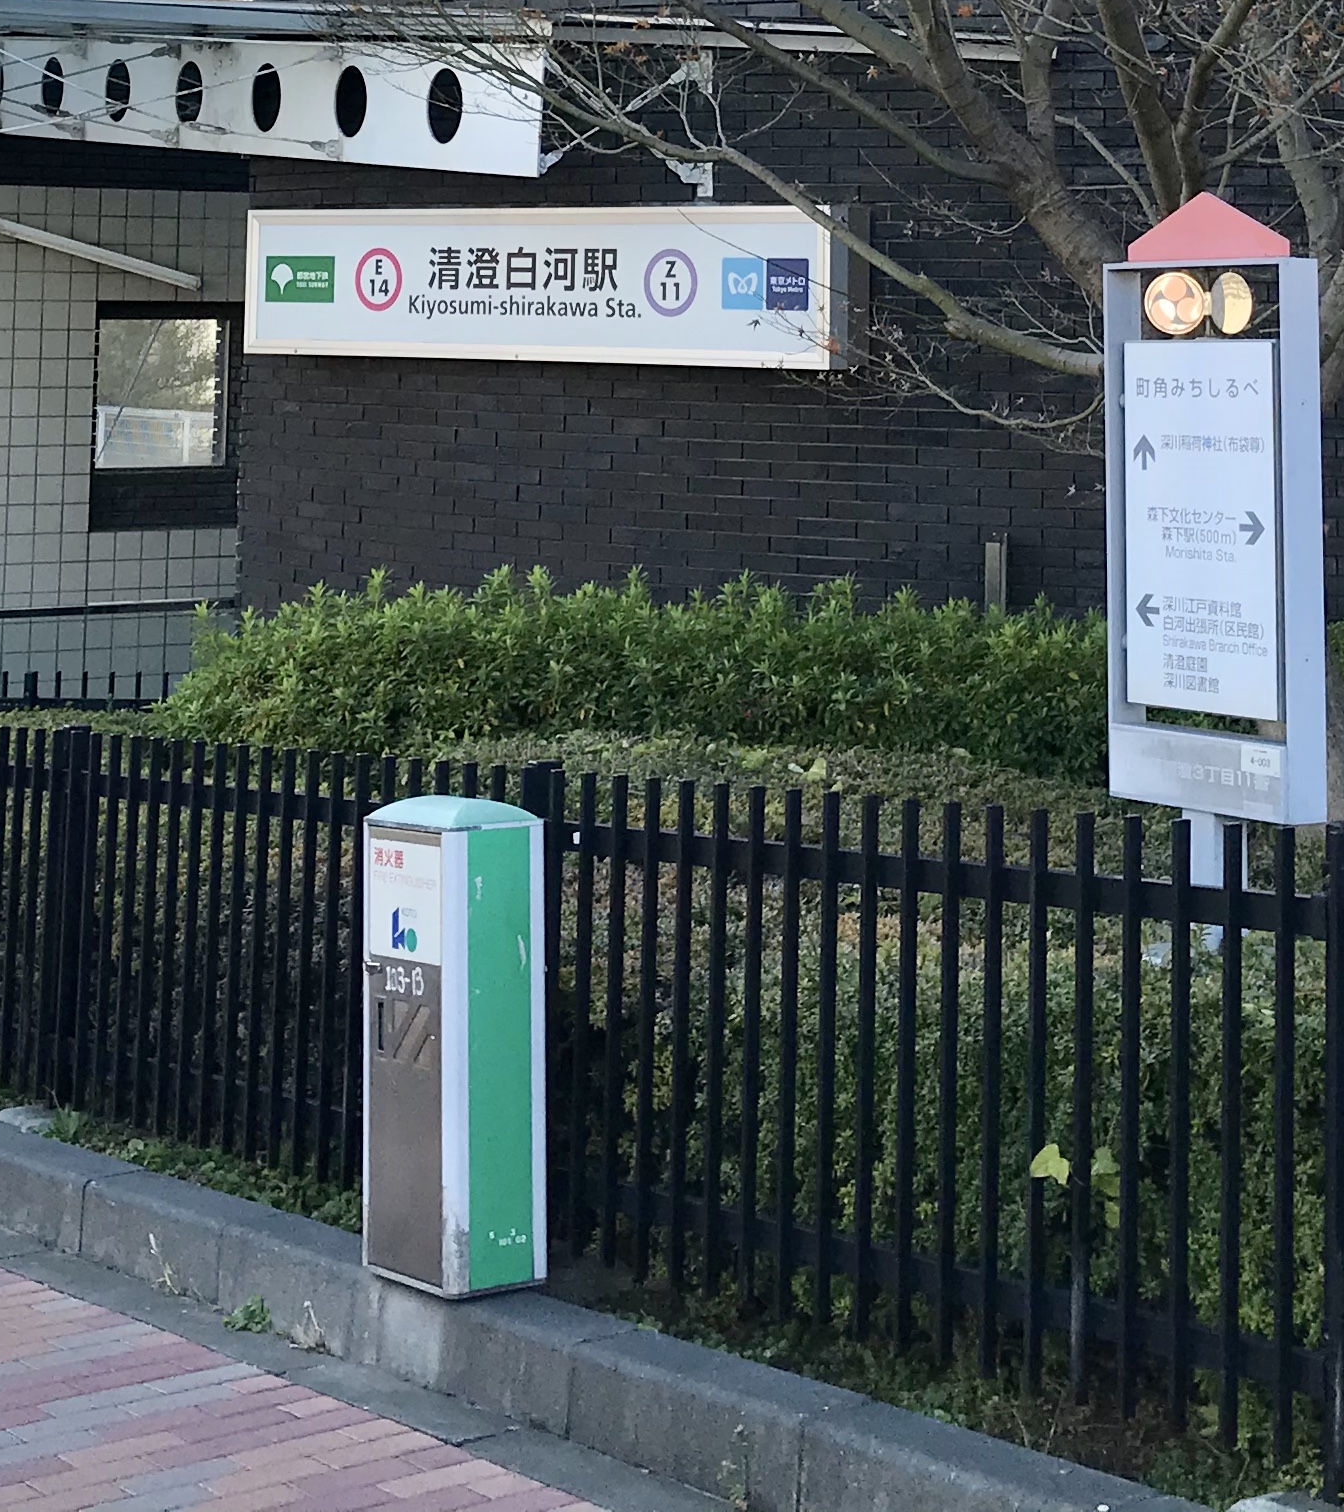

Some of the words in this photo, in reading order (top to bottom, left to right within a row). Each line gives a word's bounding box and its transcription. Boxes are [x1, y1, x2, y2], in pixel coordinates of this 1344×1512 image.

[374, 259, 383, 276] E
[428, 246, 618, 292] 清澄白河駅
[665, 260, 676, 278] Z
[369, 278, 390, 297] 14
[769, 276, 806, 286] 東京メトロ
[660, 282, 681, 302] 11
[408, 294, 598, 319] Kiyosumi-shirakawa
[605, 297, 642, 318] Sta.
[1136, 377, 1259, 399] 町角みちしるべ
[1147, 506, 1236, 526] 森下文化センター
[1165, 545, 1213, 561] Morishita
[1216, 548, 1237, 563] Sta.
[1163, 595, 1242, 619] 深川江戸資料館
[1162, 634, 1207, 651] Shirakawa
[1209, 638, 1240, 655] Branch
[1241, 642, 1268, 657] Office
[1163, 672, 1220, 694] 深川図書館
[374, 847, 404, 870] 消火器
